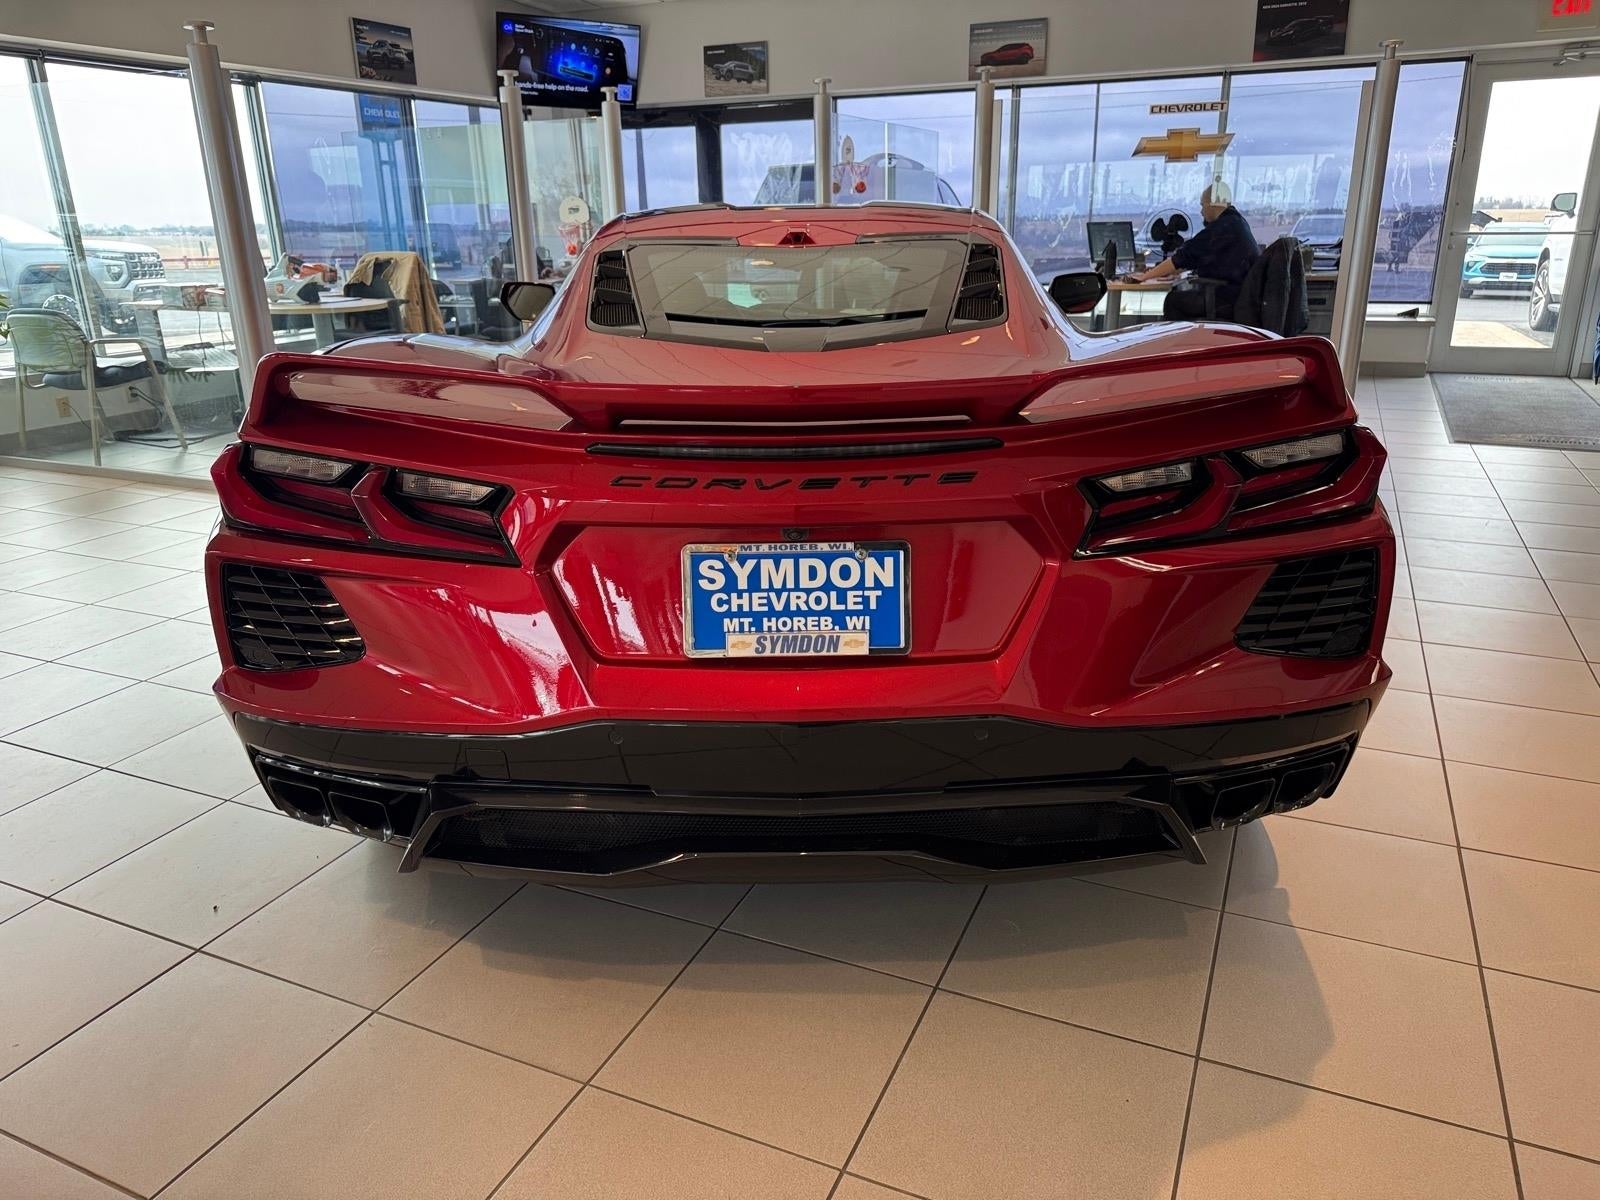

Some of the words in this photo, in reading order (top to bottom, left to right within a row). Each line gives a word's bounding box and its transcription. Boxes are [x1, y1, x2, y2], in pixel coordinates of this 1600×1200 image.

[545, 83, 557, 91] help
[565, 84, 574, 92] the
[1151, 102, 1226, 114] CHEVROLET
[609, 471, 978, 491] CORVETTE
[698, 556, 894, 591] SYMDON
[710, 590, 882, 612] CHEVROLET
[723, 617, 756, 632] MT.
[845, 615, 870, 630] WI
[754, 634, 841, 655] SYMDON
